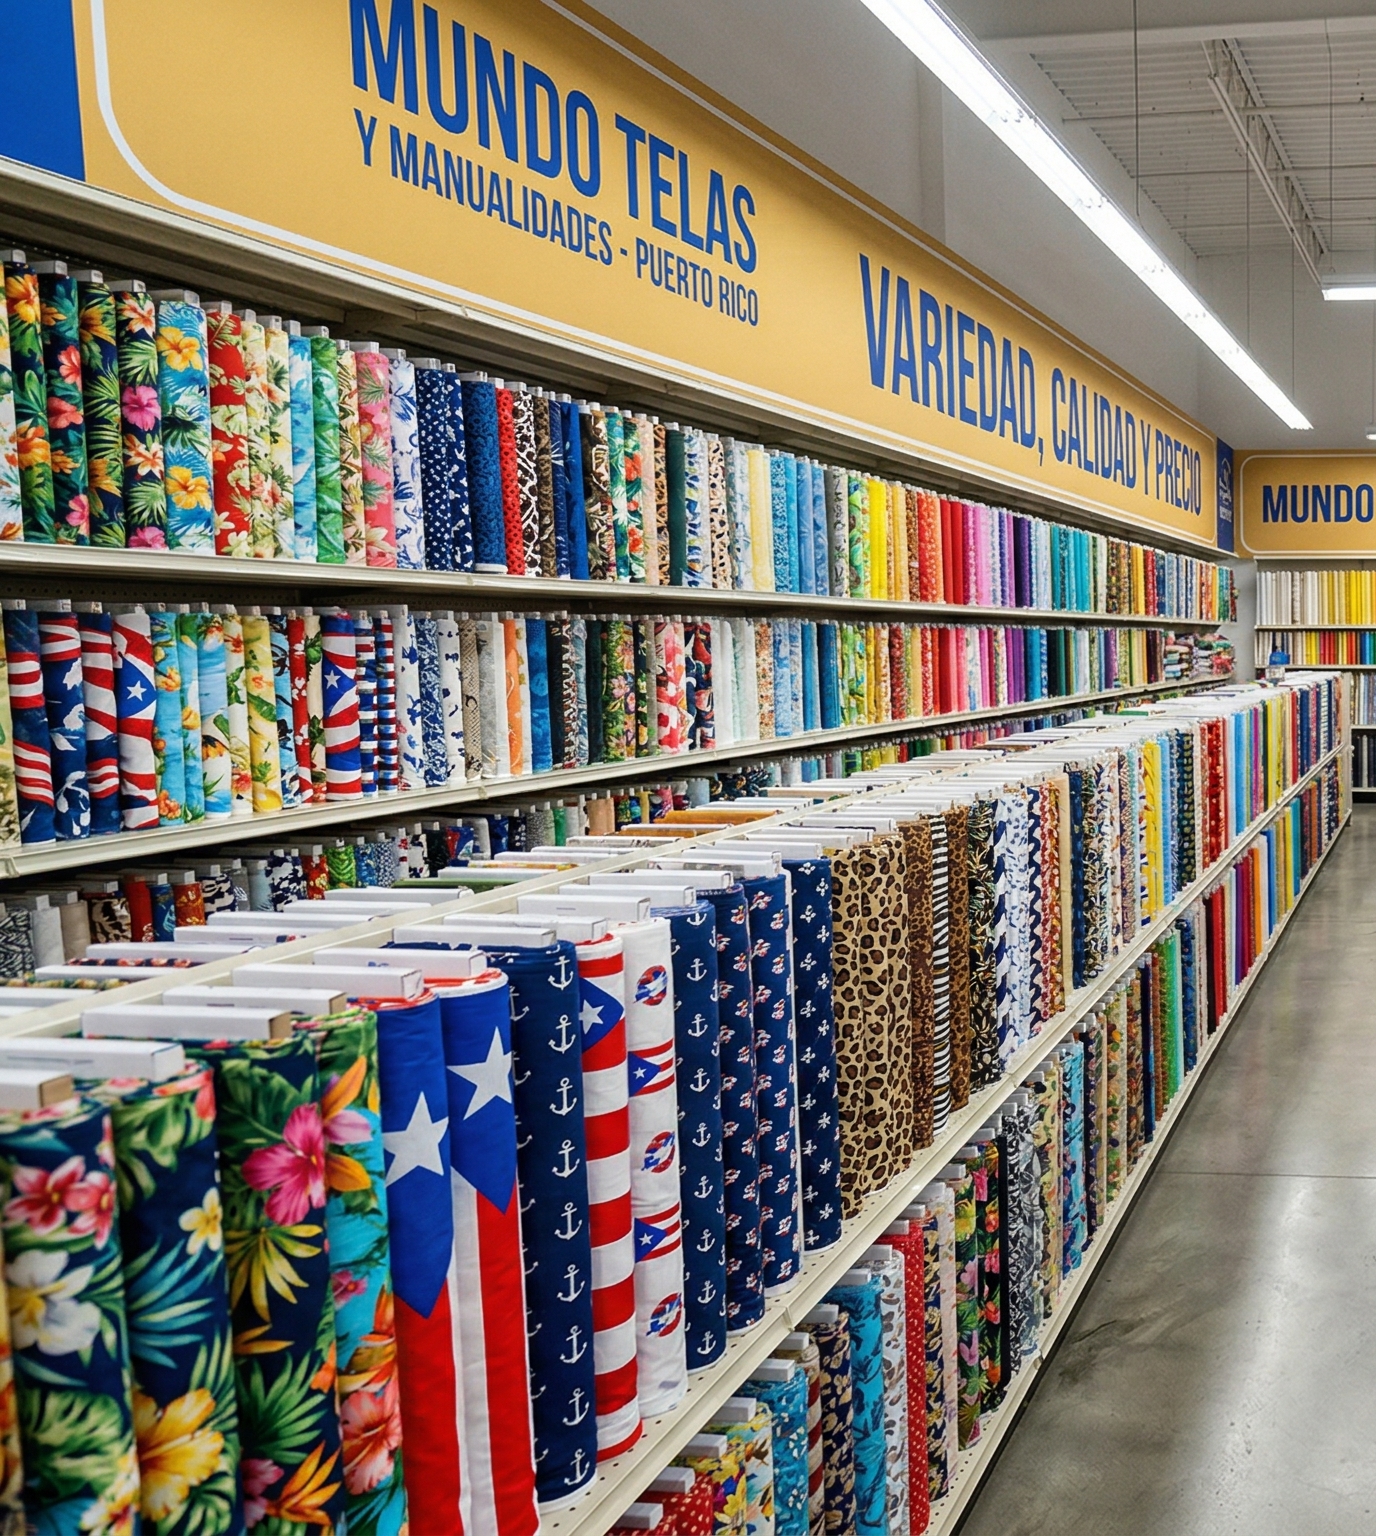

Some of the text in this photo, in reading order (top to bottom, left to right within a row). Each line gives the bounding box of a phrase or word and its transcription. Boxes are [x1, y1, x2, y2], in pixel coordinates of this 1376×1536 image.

[349, 0, 758, 274] MUNDO TELAS
[353, 107, 759, 327] Y MANUALIDADES - PUERTO RICO
[859, 253, 1045, 467] VARIEDAD,
[1051, 367, 1137, 489] CALIDAD
[1140, 419, 1151, 496] Y
[1155, 428, 1202, 516] PRECIO
[1262, 483, 1375, 523] MUNDO
